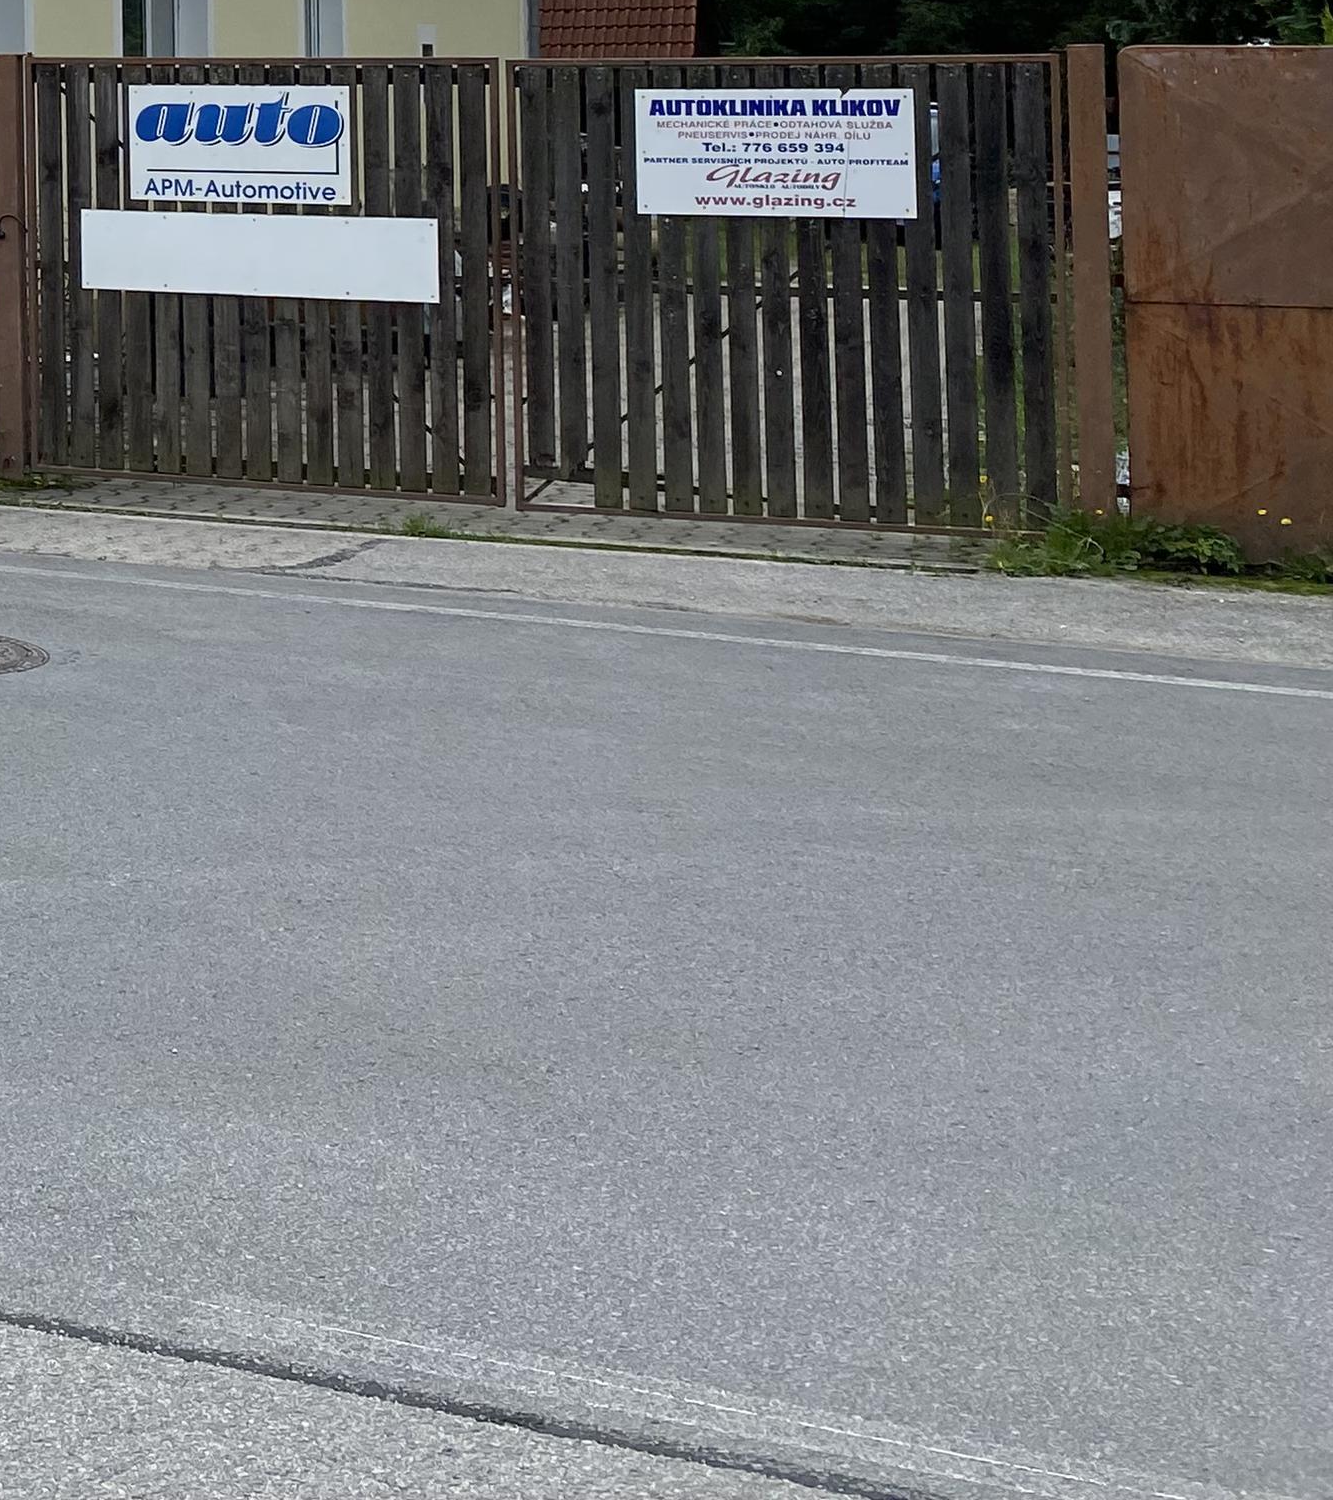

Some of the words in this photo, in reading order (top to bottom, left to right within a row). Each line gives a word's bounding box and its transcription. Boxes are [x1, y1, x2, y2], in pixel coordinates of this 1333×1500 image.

[649, 99, 807, 116] AUTOKLINIKA
[812, 99, 900, 117] KLIKOV
[135, 92, 344, 148] auto
[657, 119, 729, 128] MECHANICKÉ
[846, 120, 893, 129] SLUŽBA
[702, 142, 736, 152] Tel.:
[742, 142, 772, 152] 776
[778, 143, 808, 153] 659
[814, 143, 845, 153] 394
[692, 157, 751, 165] SERVISNÍCH
[706, 164, 841, 190] Glazing
[144, 179, 337, 200] APM-Automotive
[695, 194, 856, 209] www.glazing.cz
